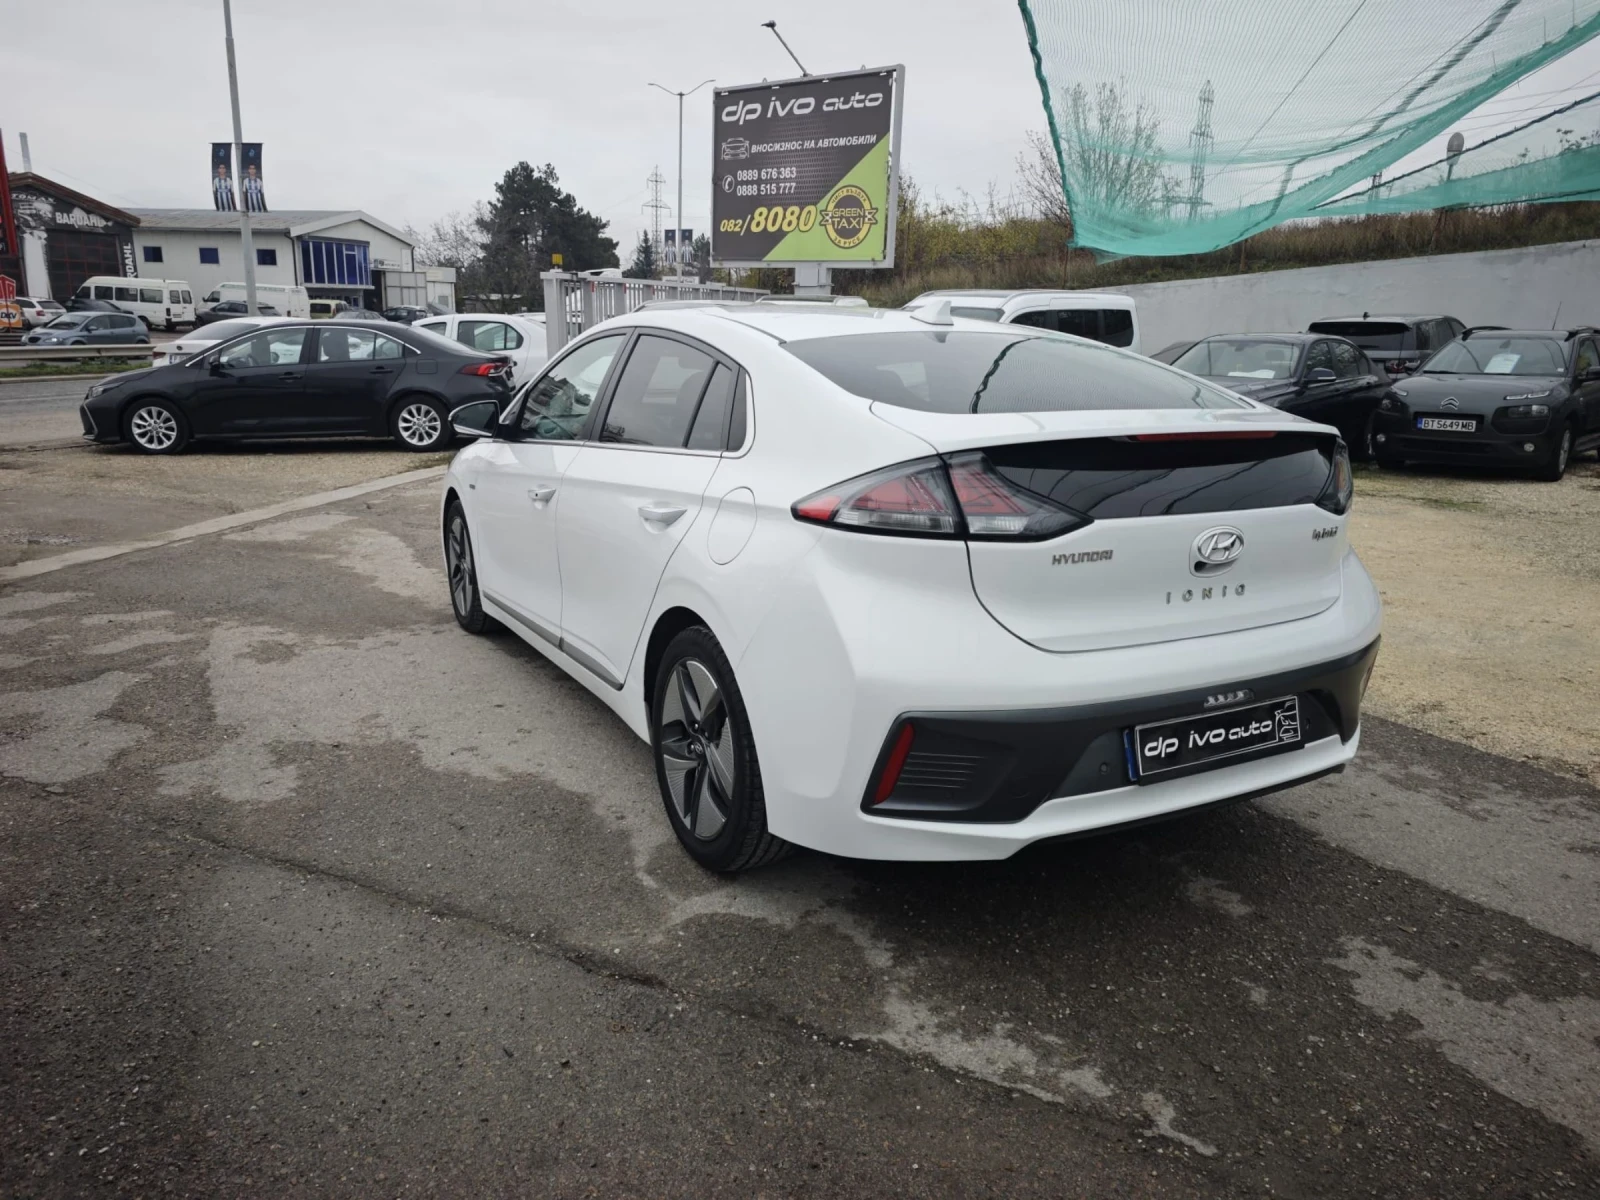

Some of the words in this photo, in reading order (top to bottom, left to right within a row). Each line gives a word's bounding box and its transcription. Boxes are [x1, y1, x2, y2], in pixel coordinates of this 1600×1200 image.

[721, 100, 762, 125] dp
[767, 96, 816, 118] ivo
[822, 92, 883, 112] auto
[751, 140, 803, 153] ВНОС/ИЗНОС
[804, 139, 815, 149] НА
[816, 134, 877, 148] АВТОМОБИЛИ
[737, 169, 758, 181] 0889
[761, 168, 778, 180] 676
[779, 167, 797, 179] 363
[736, 184, 758, 196] 0888
[760, 183, 777, 195] 515
[779, 182, 797, 194] 777
[55, 211, 106, 228] BARDAHL
[832, 207, 865, 217] GREEN
[832, 217, 863, 229] TAXI
[1052, 549, 1114, 566] HYUNDAI
[1165, 583, 1246, 605] IONIQ
[1144, 736, 1179, 758] dp
[1188, 729, 1226, 748] ivo
[1228, 719, 1273, 741] auto
